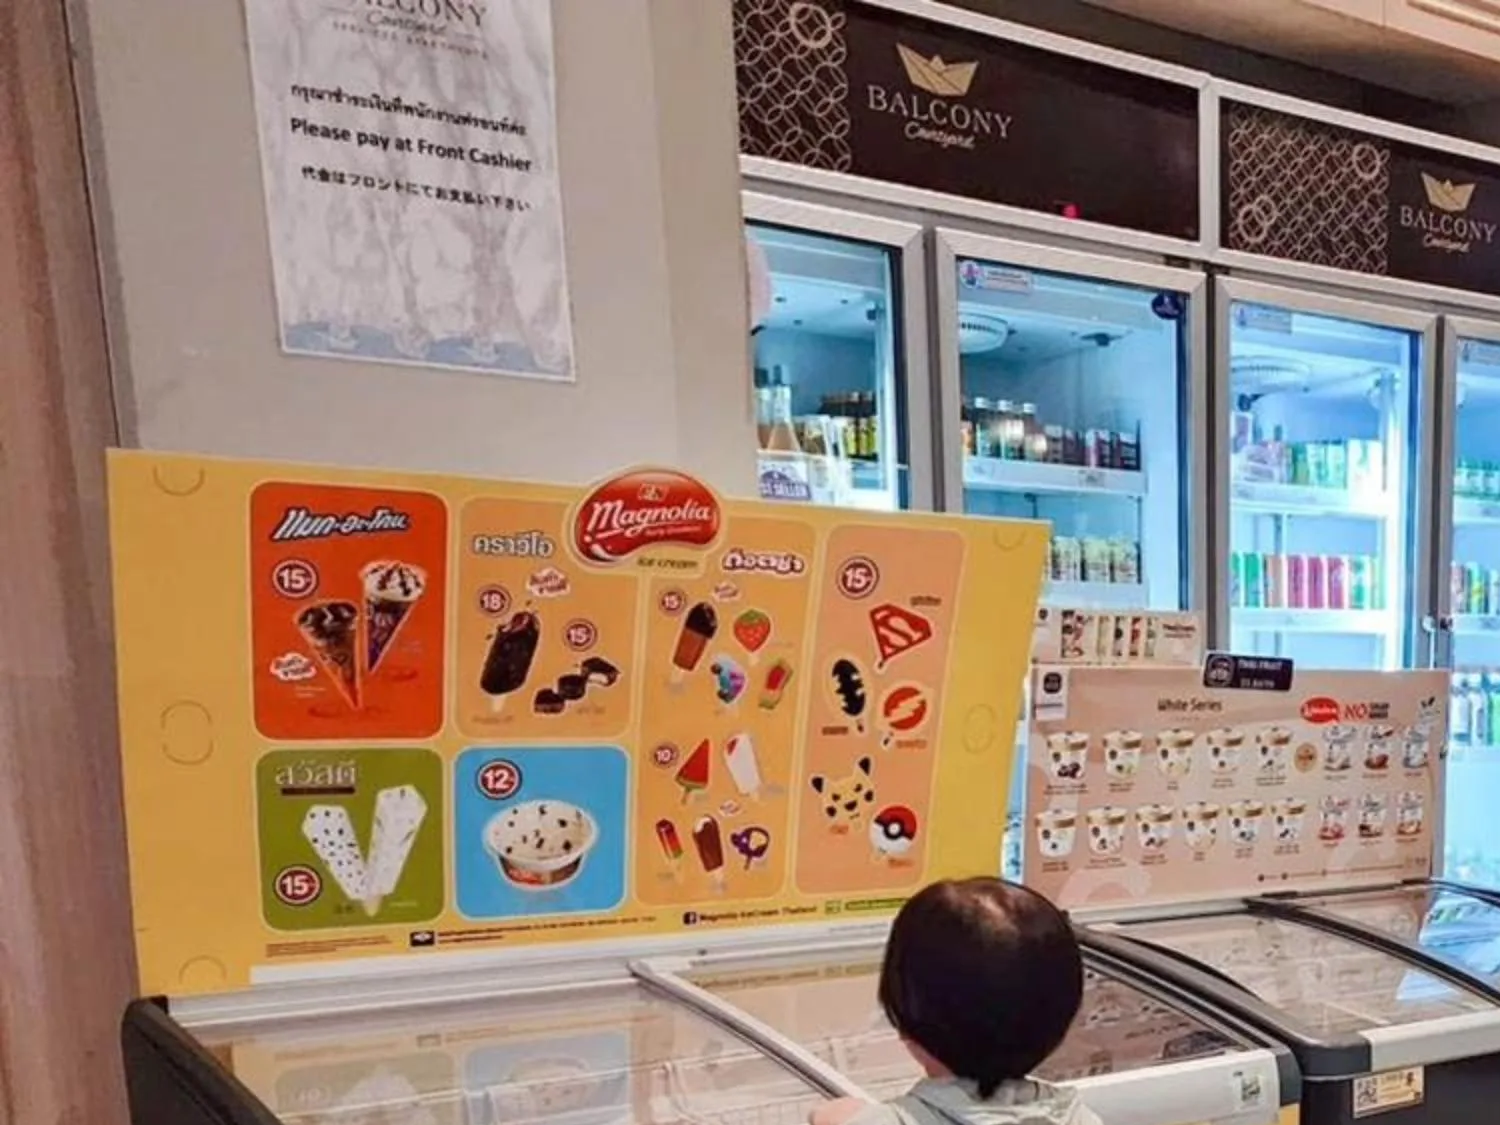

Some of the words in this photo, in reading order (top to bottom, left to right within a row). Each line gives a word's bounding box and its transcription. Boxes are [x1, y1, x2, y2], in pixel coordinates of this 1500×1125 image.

[867, 84, 1012, 139] BALCONY
[290, 117, 351, 141] Please
[356, 130, 391, 152] pay
[395, 136, 413, 151] at
[417, 138, 466, 161] Front
[469, 147, 532, 172] Cashier
[1400, 204, 1498, 244] BALCONY
[585, 499, 712, 538] Magnolia
[1157, 697, 1190, 713] White
[1191, 697, 1222, 712] Series
